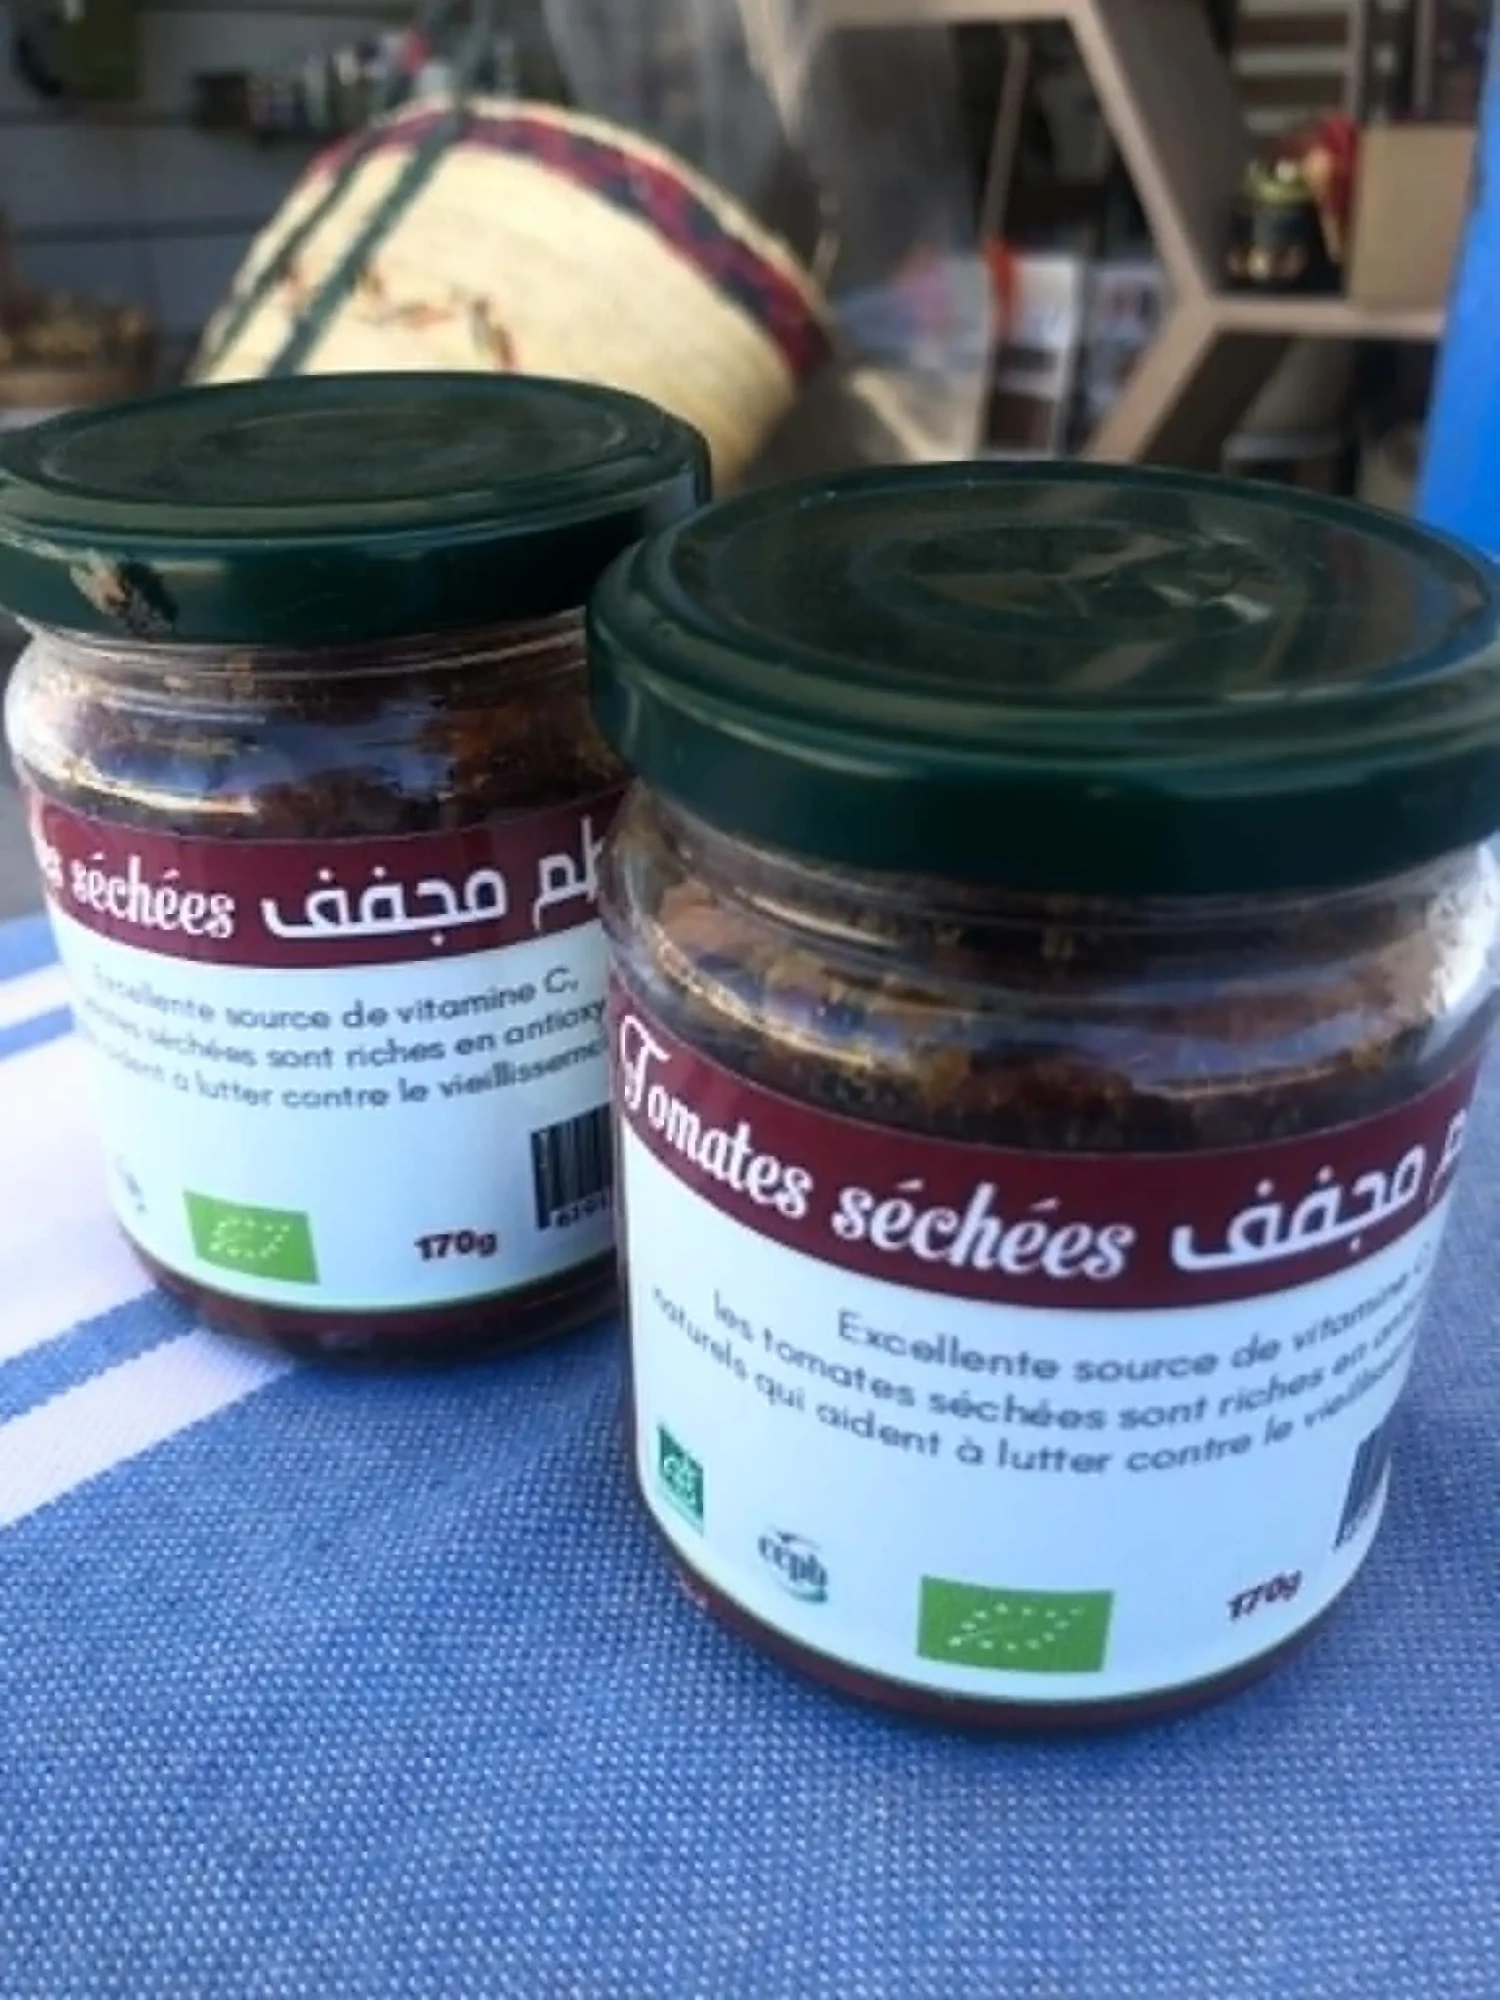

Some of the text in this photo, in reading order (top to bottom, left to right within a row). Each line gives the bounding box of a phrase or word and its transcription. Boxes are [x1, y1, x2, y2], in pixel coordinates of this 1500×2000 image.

[71, 852, 236, 939] séchées
[259, 866, 508, 947] مجفف
[225, 1006, 332, 1030] source
[342, 999, 389, 1029] de
[397, 981, 537, 1024] vitamine
[265, 1046, 334, 1070] sont
[345, 1037, 446, 1068] riches
[454, 1033, 496, 1056] en
[280, 1088, 390, 1110] contre
[399, 1076, 430, 1103] le
[619, 1014, 1137, 1280] Tomates séchées
[413, 1230, 498, 1261] 170g
[1170, 1163, 1427, 1272] مجفف
[712, 1286, 1369, 1431] les tomates séchées sont riches en
[836, 1306, 1061, 1381] Excellente
[1072, 1352, 1220, 1383] source
[1230, 1331, 1282, 1369] de
[753, 1371, 806, 1413] qui
[814, 1403, 941, 1457] aident
[955, 1434, 985, 1467] à
[996, 1436, 1114, 1475] lutter
[1124, 1433, 1253, 1473] contre
[1264, 1414, 1295, 1446] le
